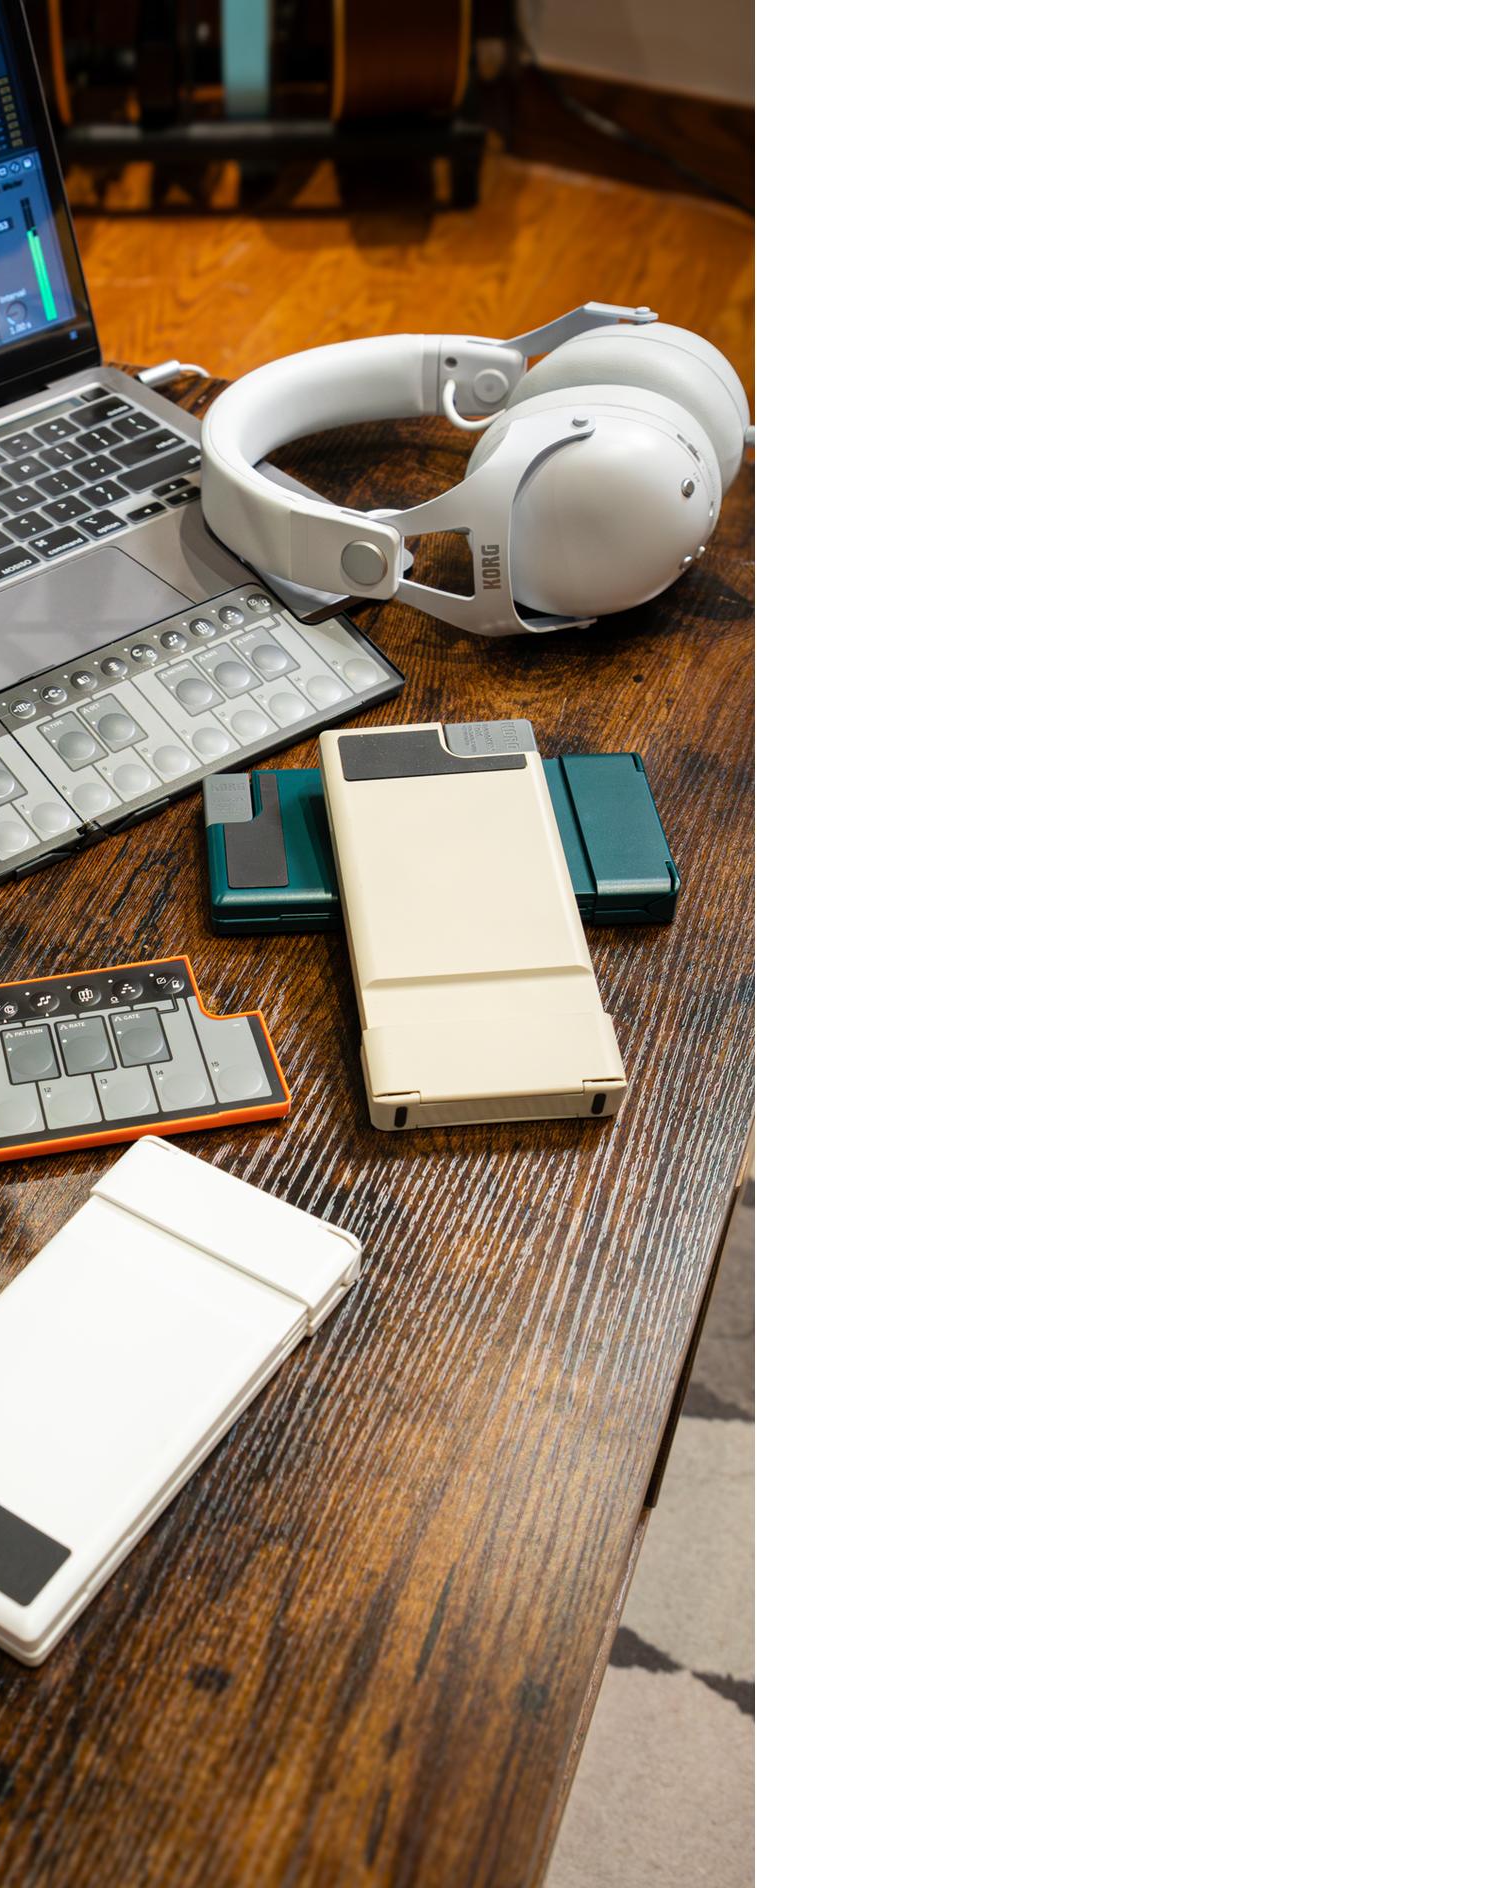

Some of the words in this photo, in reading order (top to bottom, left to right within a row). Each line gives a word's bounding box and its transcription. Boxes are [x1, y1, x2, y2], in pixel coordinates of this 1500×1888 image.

[20, 464, 31, 473] P
[48, 537, 84, 556] command
[1, 559, 33, 575] MOSISO
[480, 544, 502, 590] KORG
[68, 1021, 87, 1029] RATE
[14, 1027, 43, 1037] PATTERN
